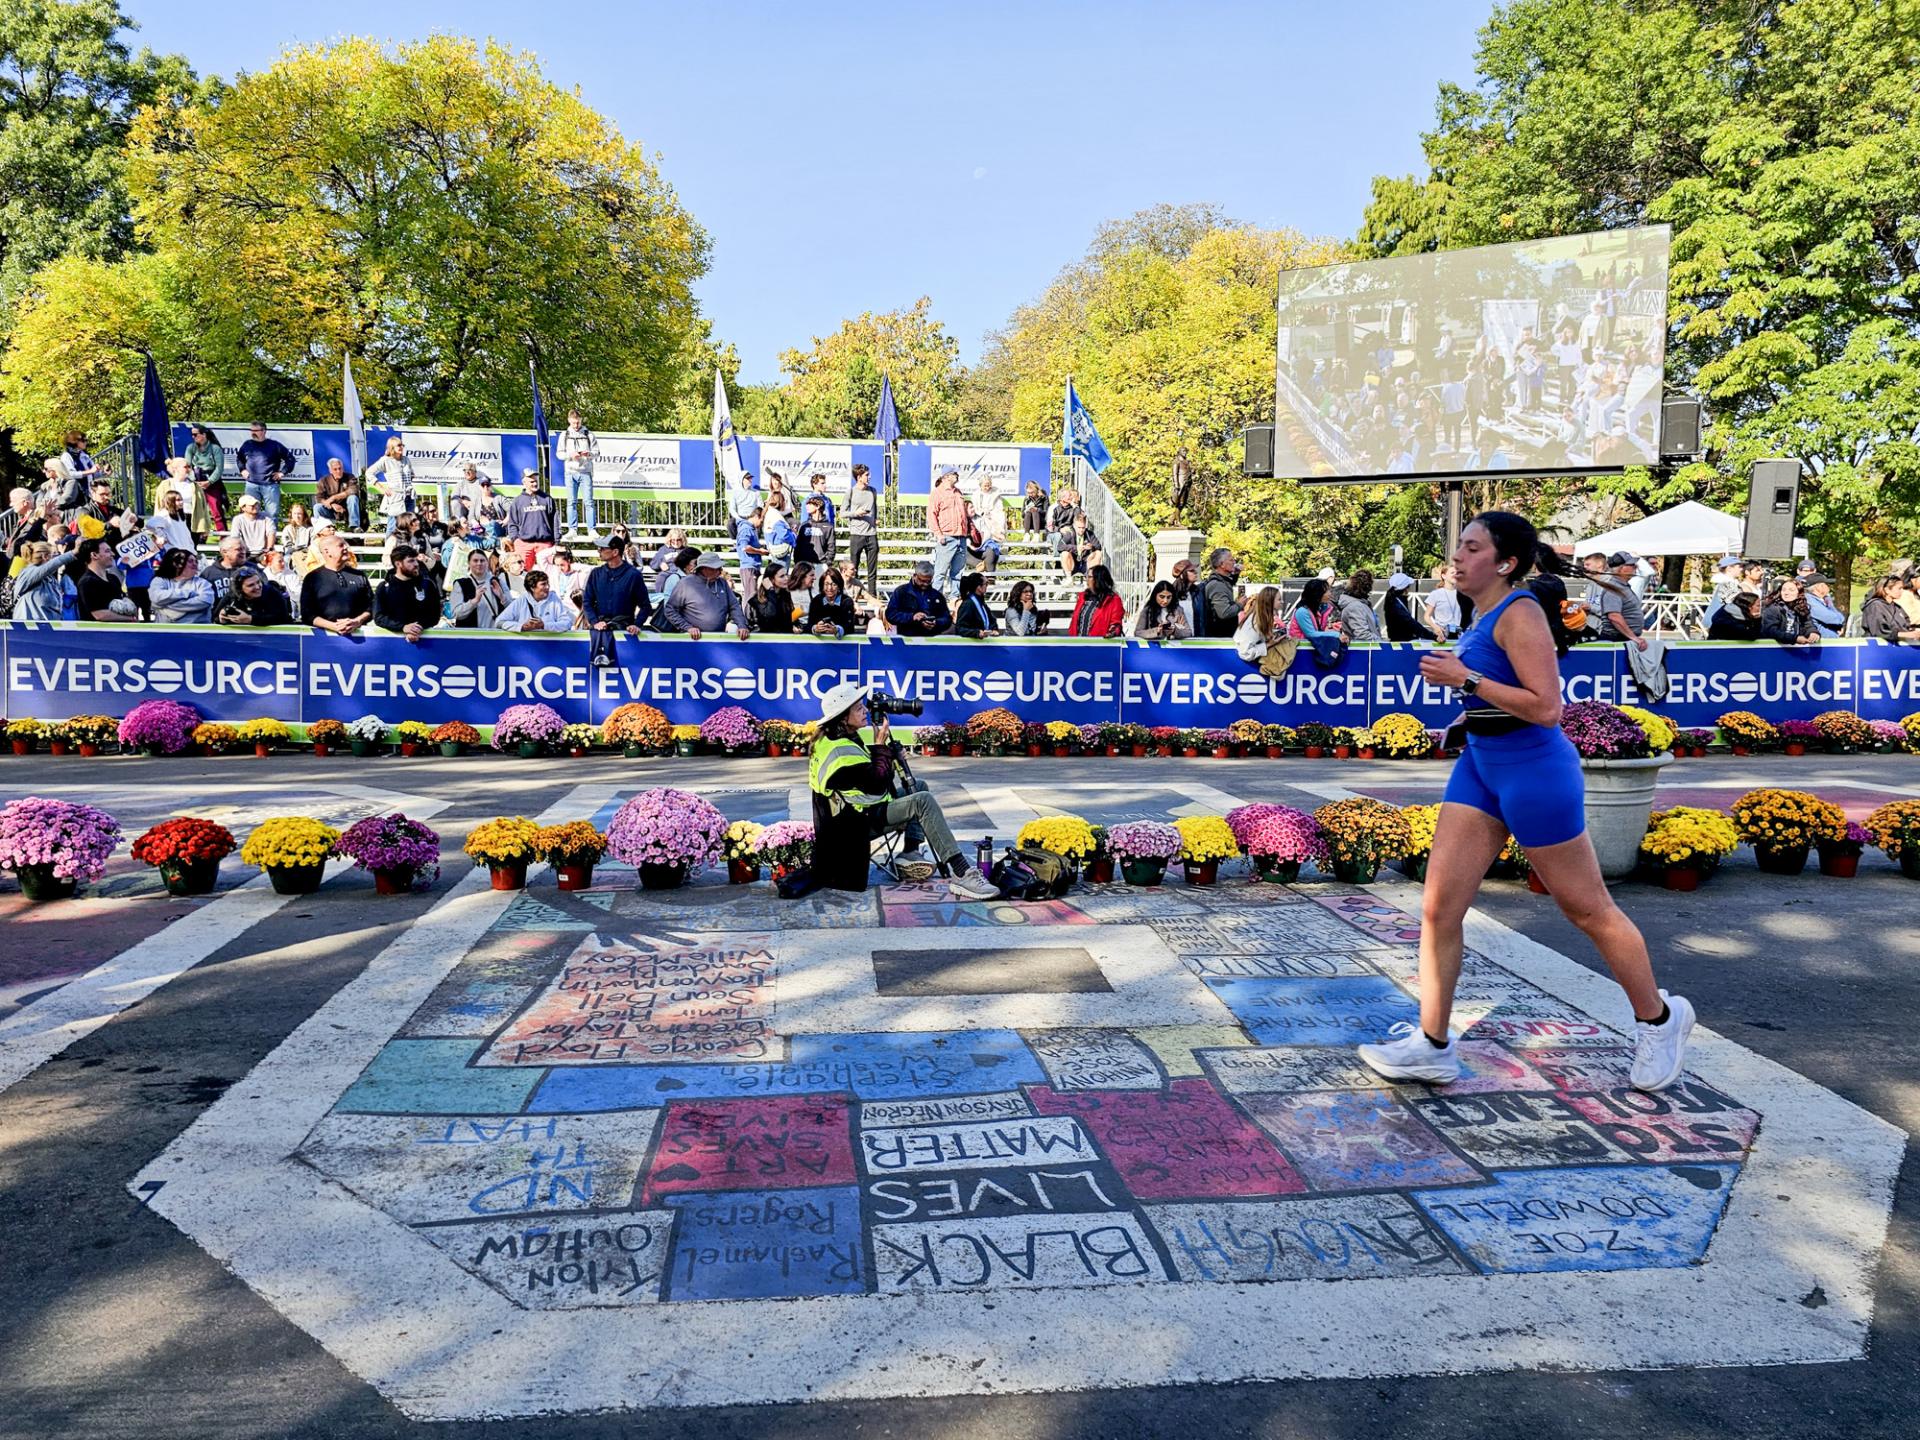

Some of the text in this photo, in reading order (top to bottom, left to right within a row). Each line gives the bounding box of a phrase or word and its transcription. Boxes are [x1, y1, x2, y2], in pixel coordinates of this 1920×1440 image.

[10, 657, 298, 695] EVERSOURCE
[309, 662, 588, 700] EVERSOURCE
[1620, 670, 1852, 704] EERSOURCE
[1122, 672, 1364, 706] EVERSOURCE
[911, 905, 1067, 927] LOVE
[582, 951, 681, 967] McCoy
[660, 960, 771, 976] Sandra
[1192, 954, 1370, 976] EQUALITY
[557, 971, 775, 994] Trayvon Martin
[578, 988, 755, 1010] Sean Bell
[588, 1006, 757, 1023] Tamir Rice
[529, 1018, 637, 1041] Taylor
[515, 1035, 768, 1064] George Floyd
[719, 1055, 938, 1076] Washington
[1059, 1063, 1154, 1088] ANTHONY
[733, 1069, 955, 1092] Stephanie
[1282, 1072, 1374, 1090] PAUL
[862, 1102, 944, 1123] NEGRON
[943, 1098, 1027, 1118] JAYSON
[667, 1130, 827, 1154] SAVES
[864, 1121, 1082, 1169] MATTER
[1155, 1136, 1271, 1162] MANY
[1554, 1122, 1743, 1158] STOP
[708, 1152, 830, 1176] ART
[1198, 1161, 1291, 1185] HOW
[869, 1169, 1115, 1218] LIVES
[693, 1196, 836, 1236] Rogers
[1428, 1194, 1670, 1222] DOWDELL
[470, 1223, 652, 1267] Outlaw
[1173, 1213, 1449, 1279] ENOUGH
[1514, 1228, 1634, 1254] ZOE
[884, 1224, 1150, 1288] BLACK
